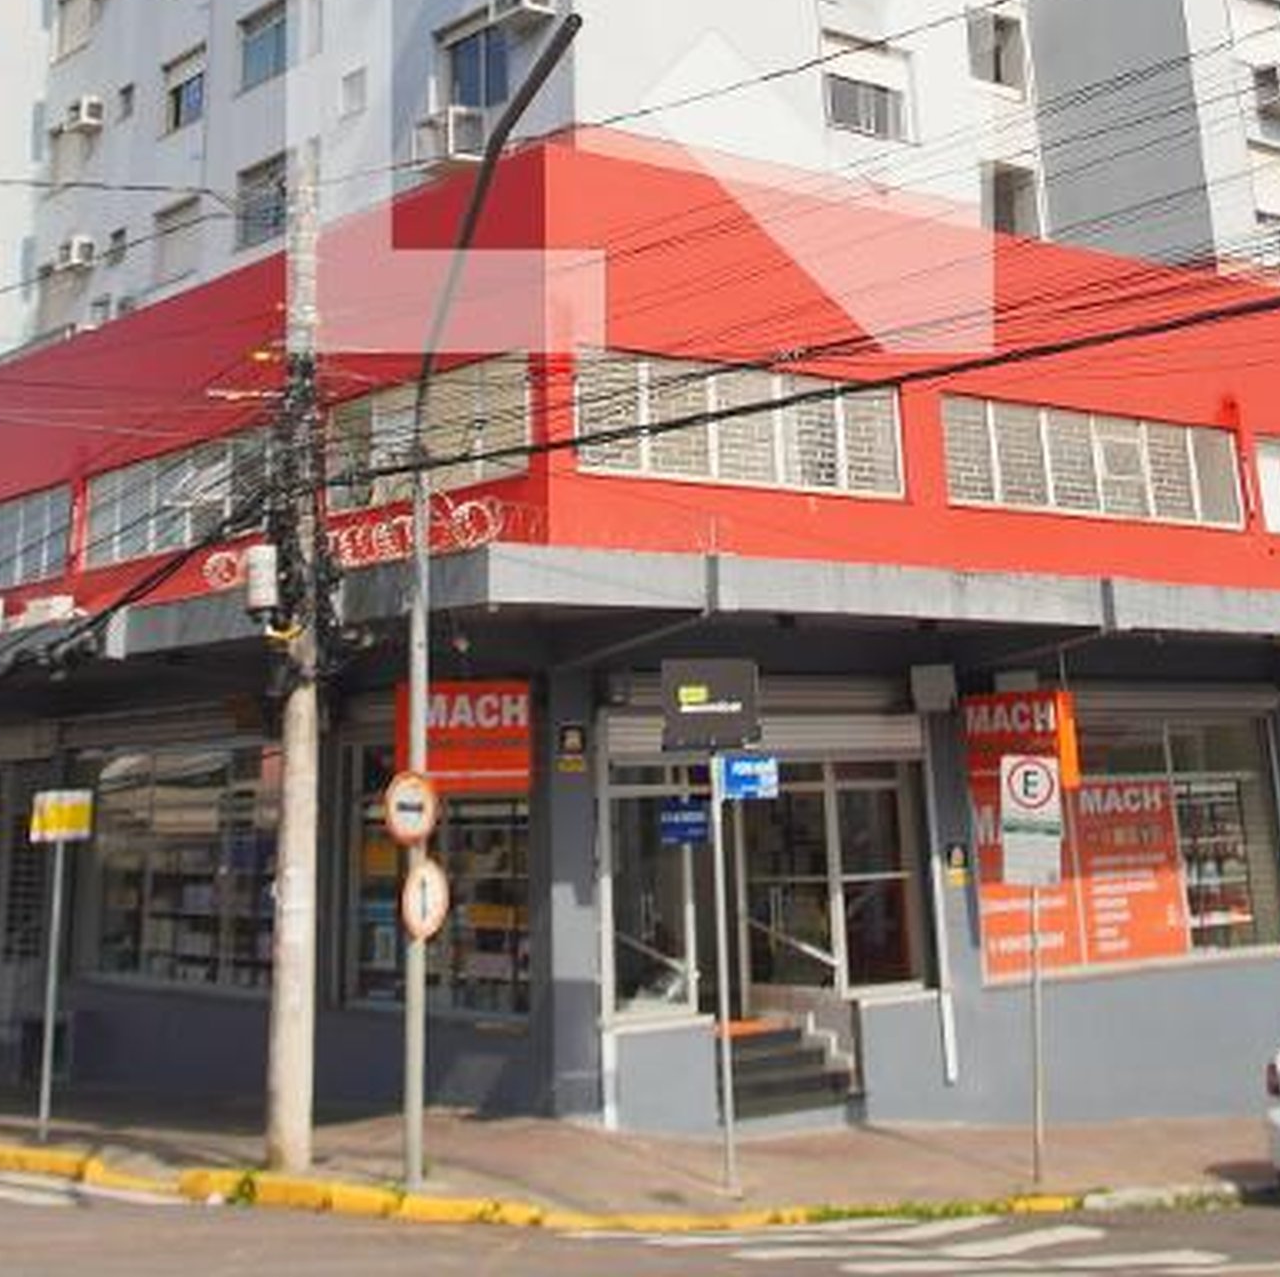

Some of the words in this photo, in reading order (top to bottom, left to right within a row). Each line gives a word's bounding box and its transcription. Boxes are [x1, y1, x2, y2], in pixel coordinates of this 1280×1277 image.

[426, 692, 529, 729] MACH
[966, 701, 1056, 735] MACH
[1023, 770, 1039, 799] E
[1079, 785, 1164, 815] MACH
